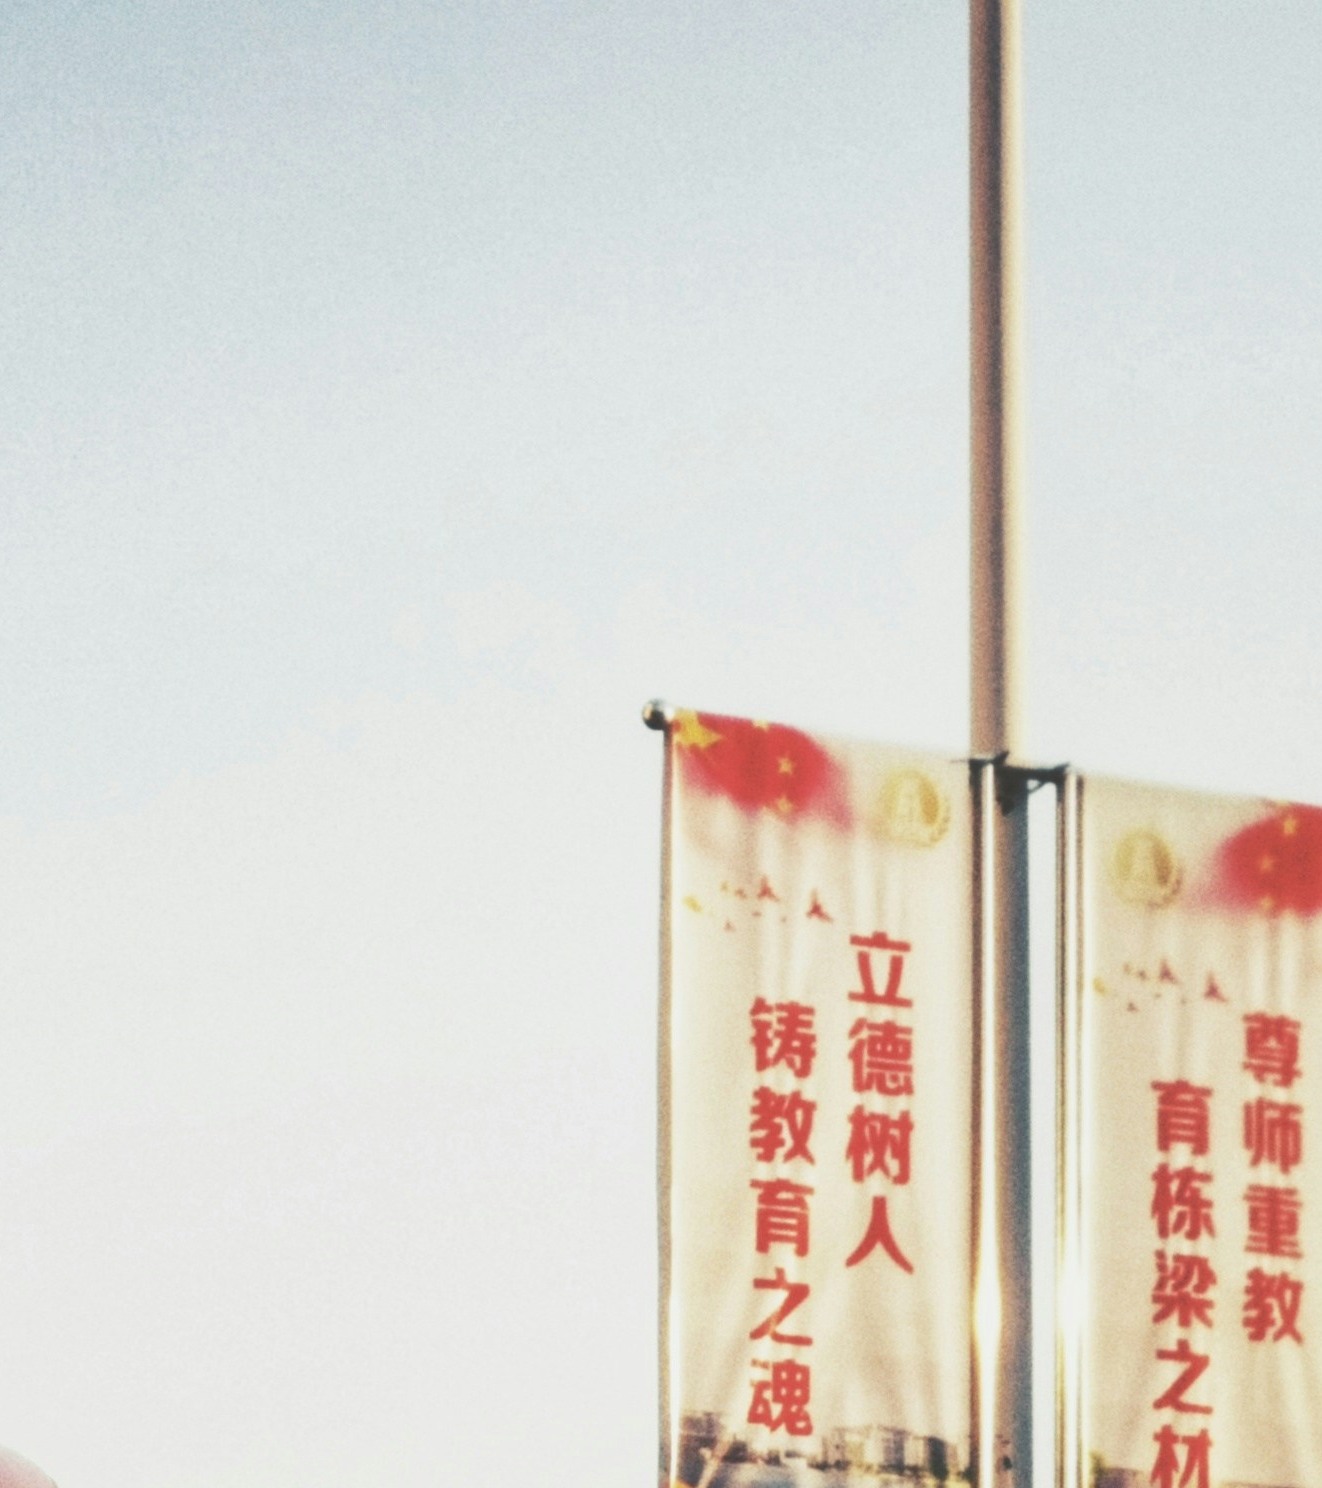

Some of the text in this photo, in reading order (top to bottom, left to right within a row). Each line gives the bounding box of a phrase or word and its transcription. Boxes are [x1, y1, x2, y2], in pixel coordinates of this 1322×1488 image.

[748, 997, 817, 1437] 铸教育之魂
[846, 931, 914, 1275] 立德树人
[1242, 1012, 1305, 1345] 尊师重教
